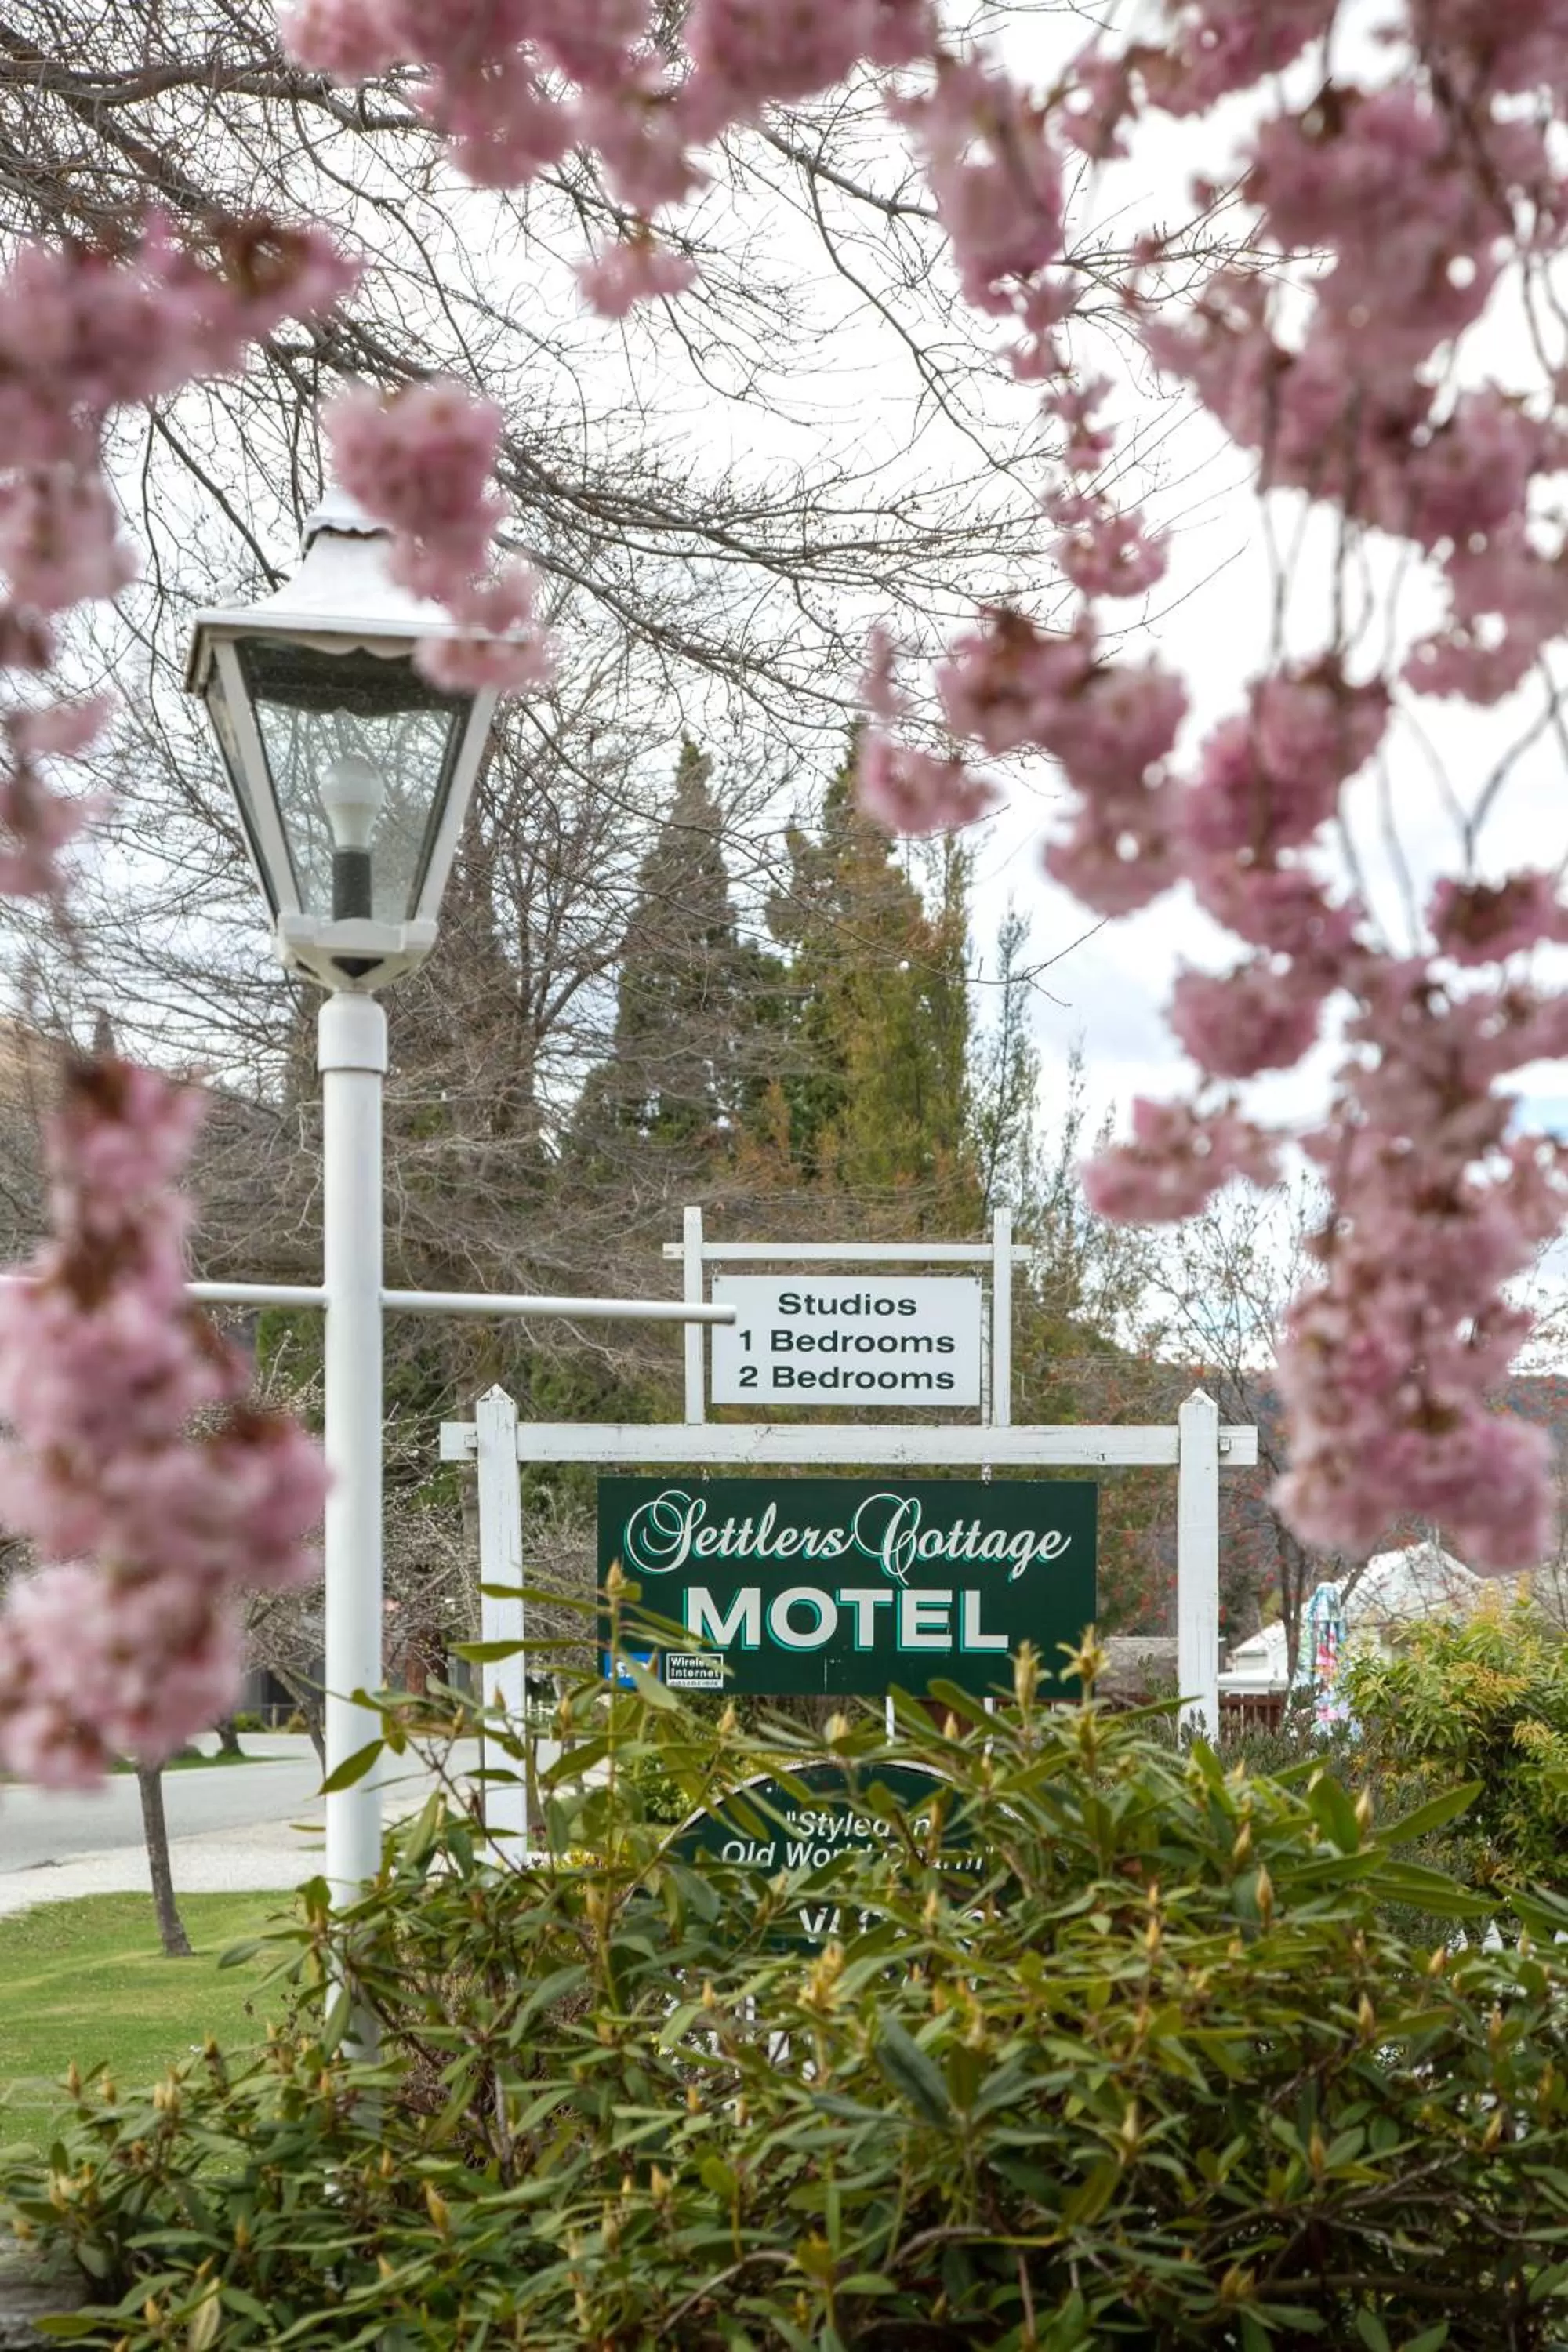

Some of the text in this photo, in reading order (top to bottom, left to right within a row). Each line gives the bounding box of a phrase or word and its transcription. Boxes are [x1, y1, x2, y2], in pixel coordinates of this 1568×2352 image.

[778, 1292, 917, 1316] Studios
[739, 1329, 956, 1354] 1 Bedrooms
[739, 1365, 956, 1390] 2 Bedrooms
[625, 1490, 1071, 1587] Settlers Cottage
[683, 1586, 1009, 1652] MOTEL
[670, 1657, 718, 1668] Wirele
[670, 1668, 719, 1678] Internet
[722, 1840, 775, 1867] Old
